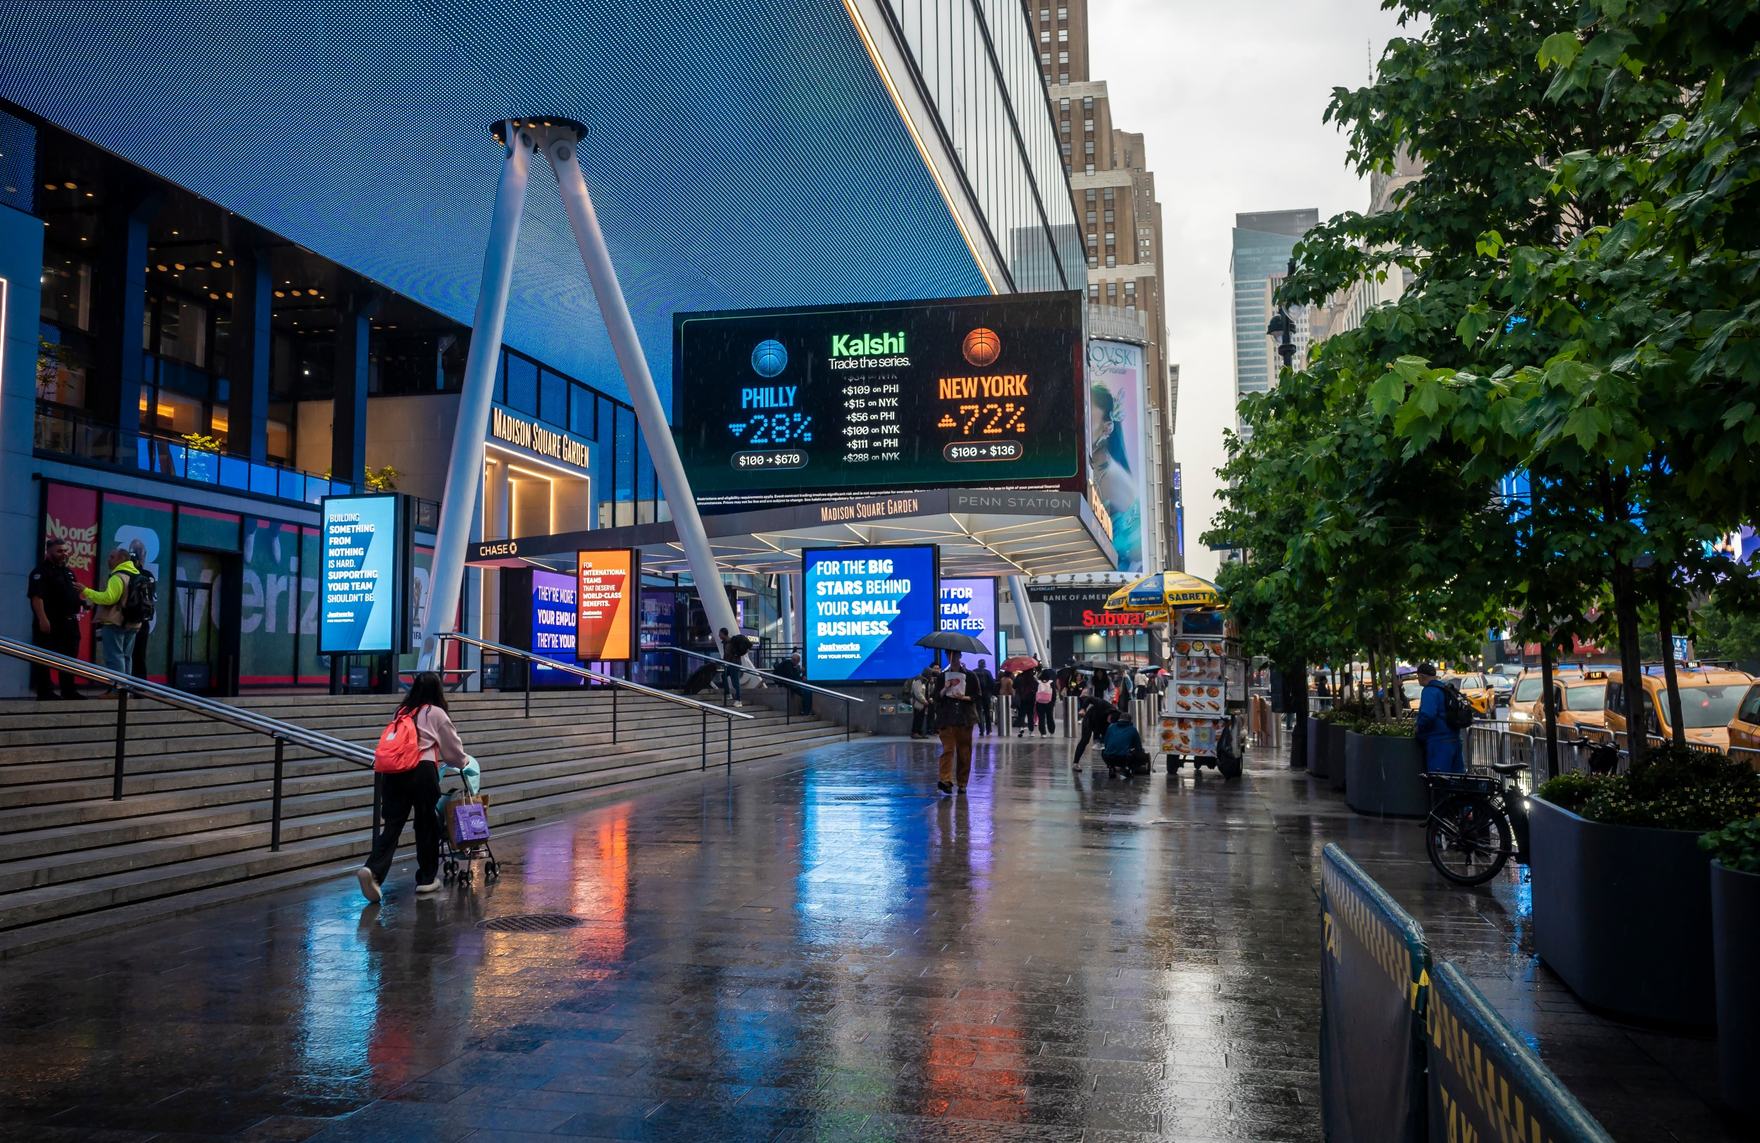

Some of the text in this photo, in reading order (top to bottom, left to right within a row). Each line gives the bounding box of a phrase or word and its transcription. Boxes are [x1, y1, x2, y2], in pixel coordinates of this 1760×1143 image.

[833, 331, 905, 357] Kalshi
[1090, 345, 1136, 366] OVSKI
[828, 356, 911, 370] Trade the series.
[842, 385, 870, 396] +$109
[882, 384, 900, 394] PHI
[939, 374, 1029, 400] NEW YORK
[742, 386, 798, 409] PHILLY
[844, 398, 866, 410] +$15
[878, 398, 898, 408] NYK
[846, 412, 868, 423] +$56
[880, 411, 895, 420] PHI
[960, 403, 1026, 434] 72%
[750, 412, 812, 444] 28%
[842, 426, 870, 437] +$100
[881, 424, 900, 434] NYK
[846, 439, 868, 450] +$111
[883, 438, 898, 448] PHI
[842, 452, 870, 463] +$288
[881, 452, 900, 461] NYK
[951, 444, 1016, 459] $100 $136
[739, 454, 800, 467] $100 $670
[958, 496, 1072, 508] PENN STATION
[329, 513, 360, 522] BUILDING
[329, 524, 376, 534] SOMETHING
[328, 536, 352, 546] FROM
[328, 548, 364, 558] NOTHING
[480, 544, 508, 556] CHASE
[328, 560, 356, 568] IS HARD.
[816, 559, 894, 576] FOR THE BIG
[328, 570, 378, 580] SUPPORTING
[328, 582, 374, 592] YOUR TEAM
[816, 579, 911, 596] STARS BEHIND
[950, 588, 972, 599] FOR
[816, 600, 901, 616] YOUR SMALL
[538, 608, 555, 624] YOUR
[1082, 609, 1148, 628] Subway
[817, 620, 893, 636] BUSINESS.
[940, 618, 986, 630] DEN FEES.
[537, 632, 576, 648] THEY'RE YOUR
[818, 642, 860, 652] Justworks
